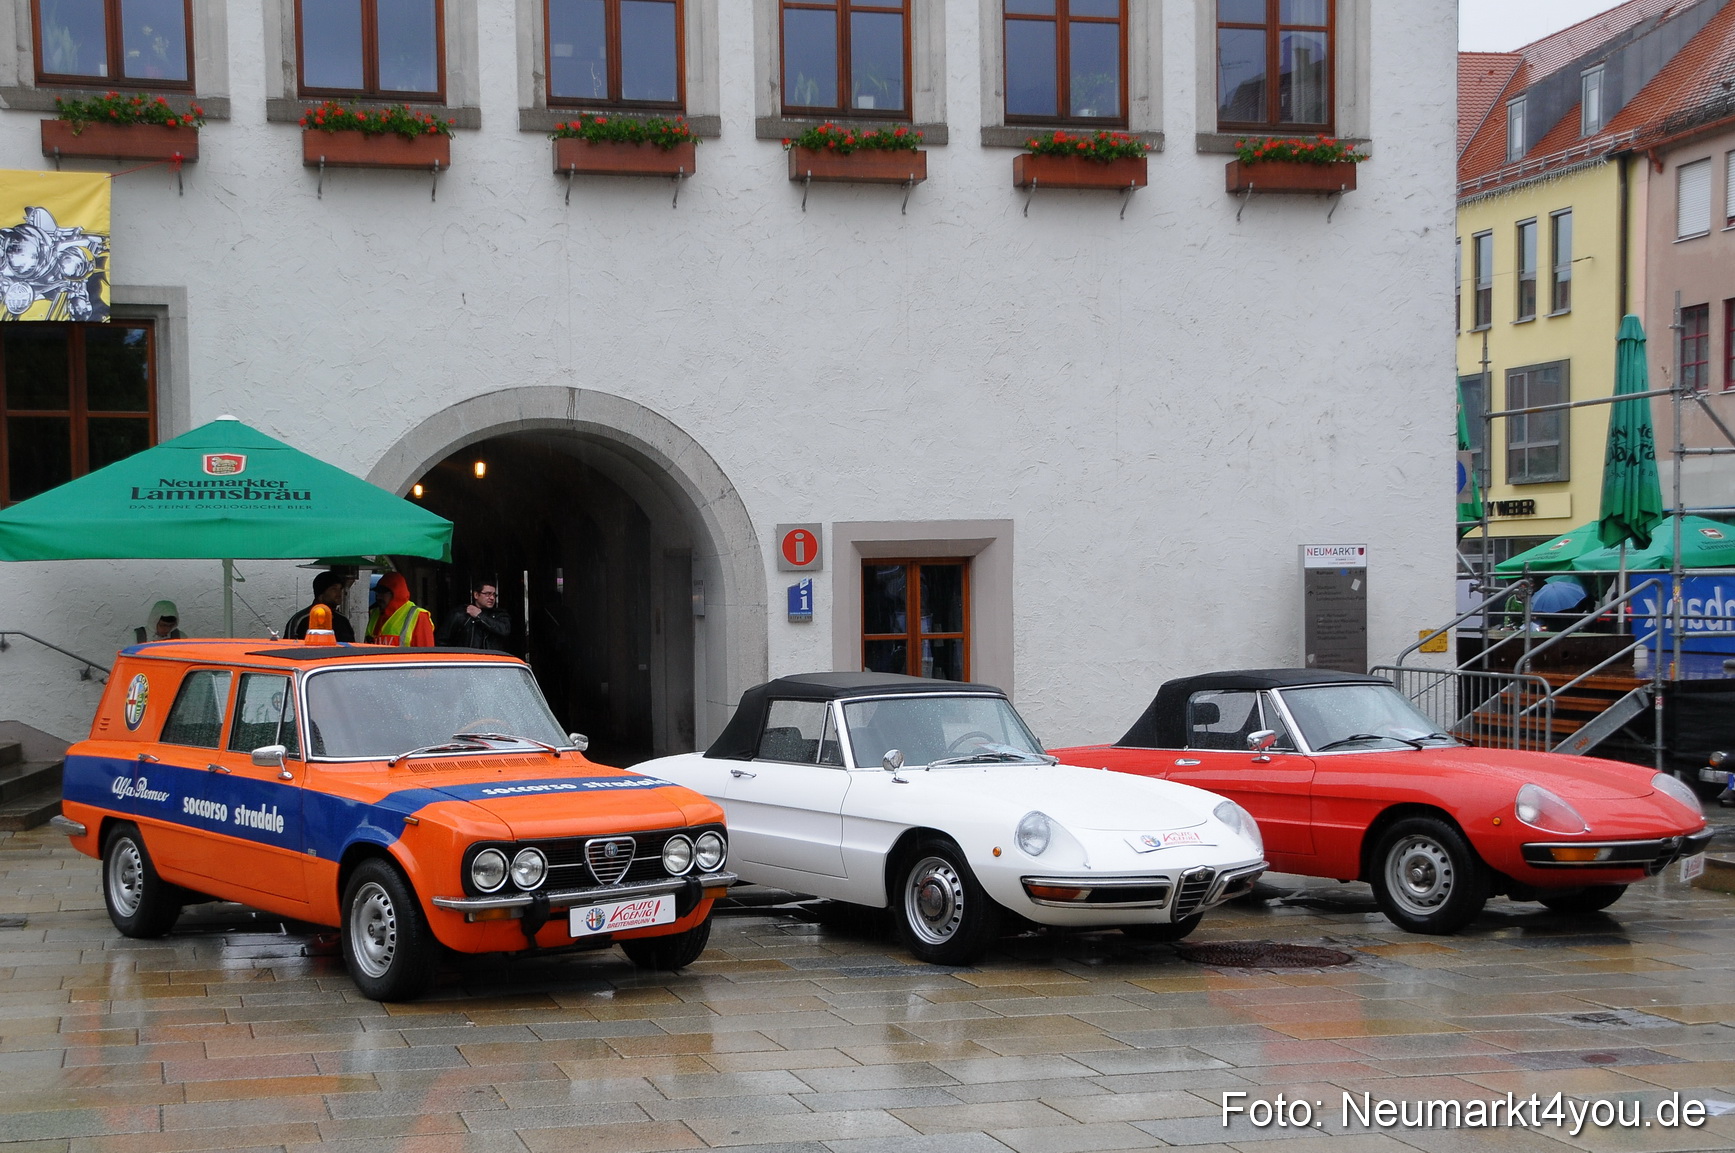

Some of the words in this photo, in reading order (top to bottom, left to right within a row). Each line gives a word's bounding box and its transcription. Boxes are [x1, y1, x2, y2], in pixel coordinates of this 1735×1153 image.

[159, 478, 289, 489] Neumarkter
[131, 487, 312, 501] Lammsbräu
[1496, 499, 1536, 516] WEBER
[1306, 547, 1356, 557] NEUMARKT
[112, 775, 136, 800] Alfa
[135, 777, 170, 802] Romeo
[482, 783, 577, 796] soccorso
[582, 778, 673, 790] stradale
[183, 796, 228, 822] soccorso
[234, 803, 284, 834] stradale
[628, 901, 654, 911] AUTO
[607, 918, 651, 929] BREITENBRUNN
